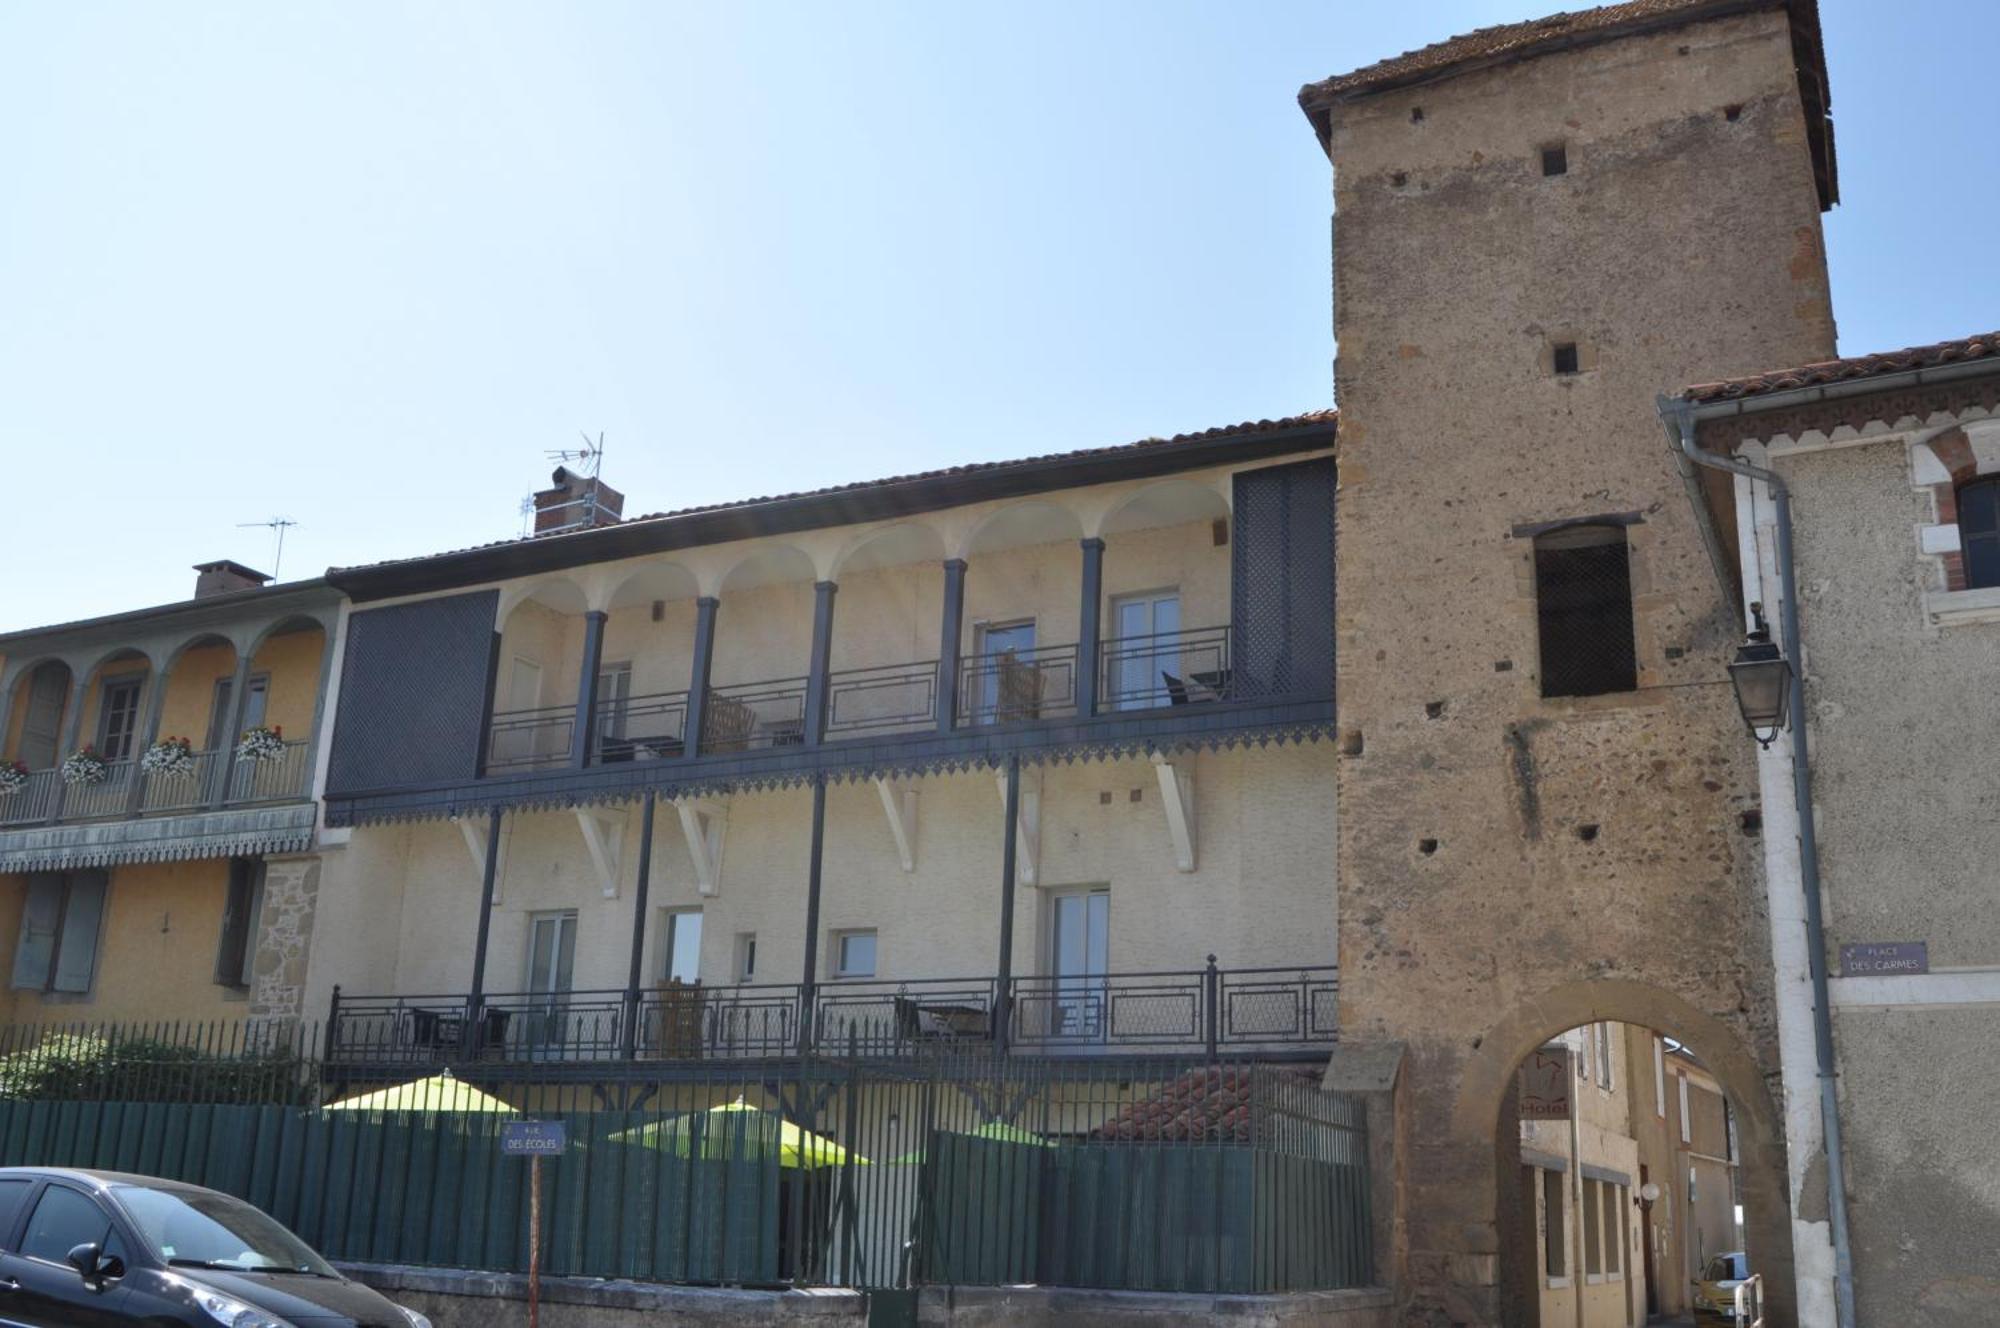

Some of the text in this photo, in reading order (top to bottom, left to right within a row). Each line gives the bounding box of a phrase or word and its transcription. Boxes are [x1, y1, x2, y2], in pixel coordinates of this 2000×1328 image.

[1868, 946, 1897, 957] PLACE
[1850, 959, 1919, 971] DES CARMES
[508, 1139, 522, 1149] DES
